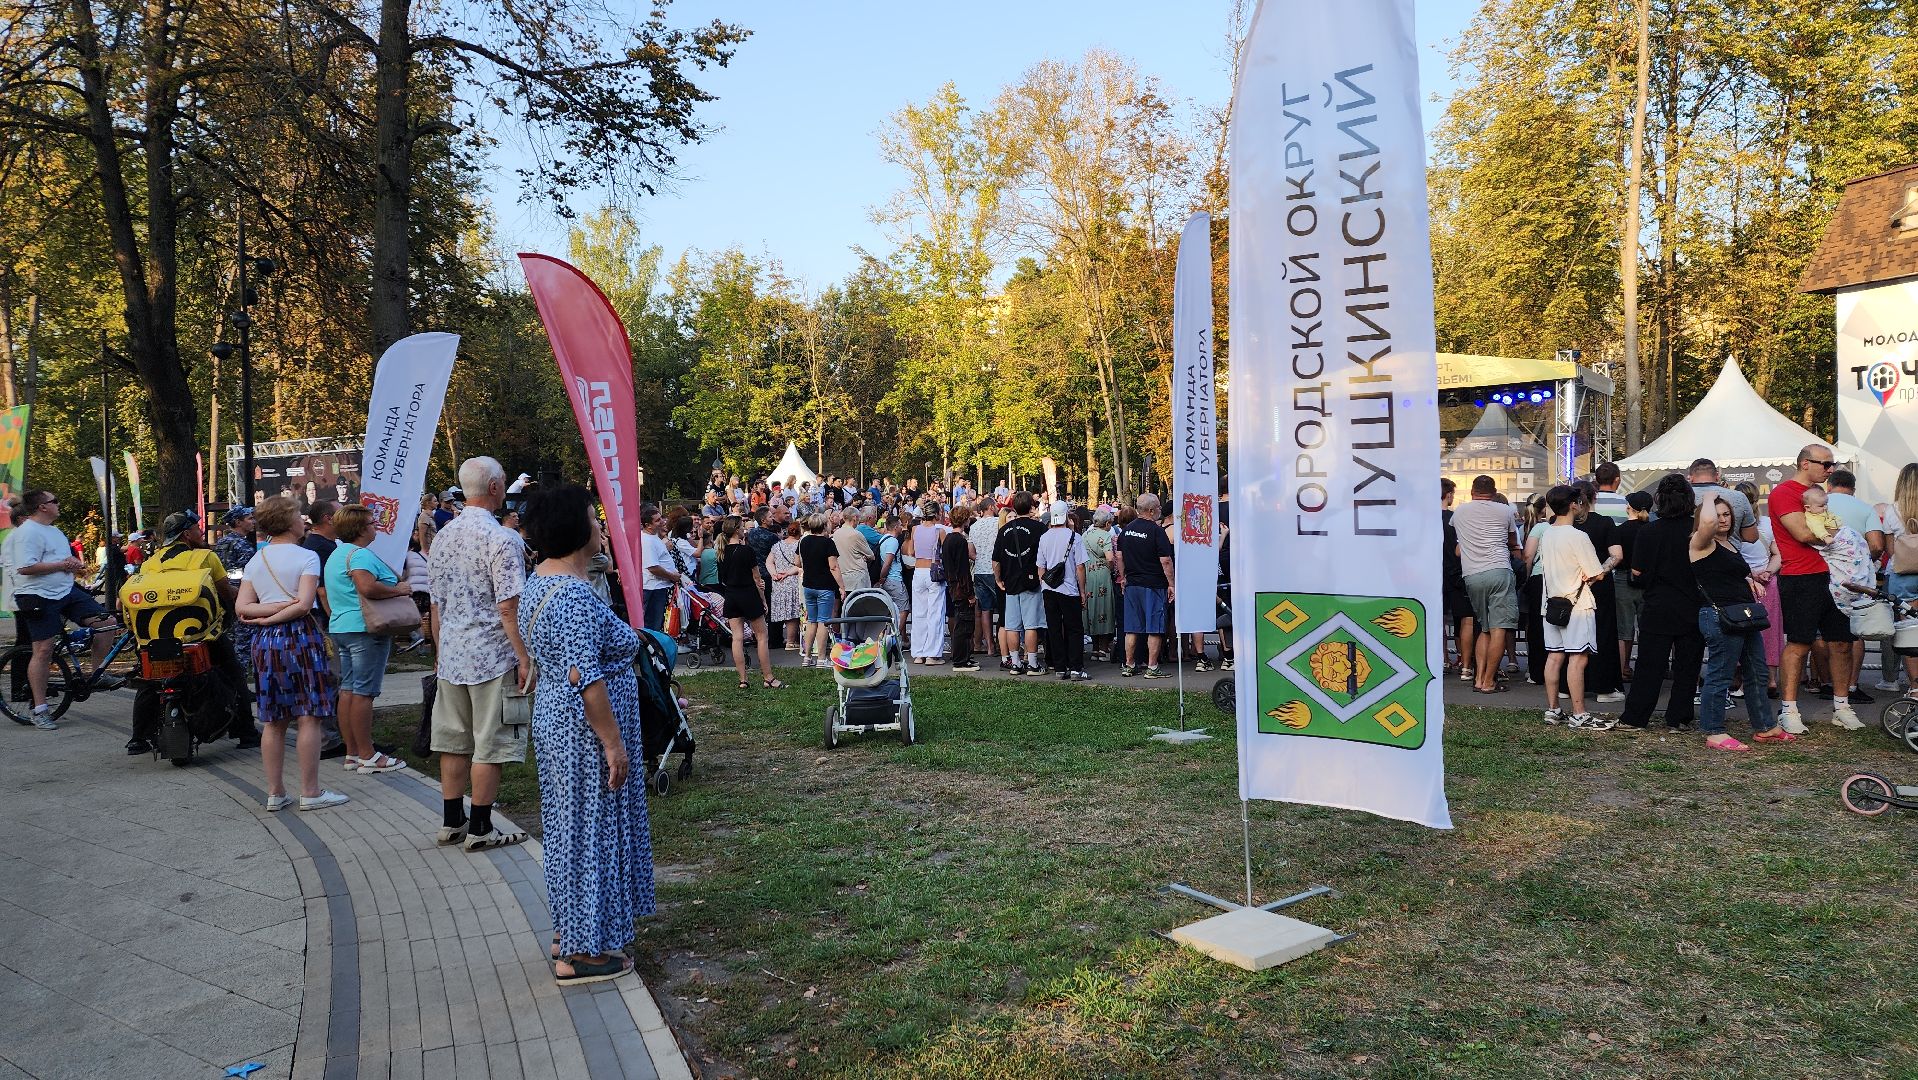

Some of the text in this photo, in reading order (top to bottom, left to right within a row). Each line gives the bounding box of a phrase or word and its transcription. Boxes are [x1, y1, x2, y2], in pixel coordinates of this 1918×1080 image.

[1281, 82, 1332, 537] ГОРОДСКОЙ ОКРУГ
[1322, 63, 1398, 537] ПУШКИНСКИЙ
[1863, 331, 1918, 347] МОЛОД
[371, 406, 401, 481] КОМАНДА
[389, 382, 426, 485] ГУБЕРНАТОРА
[1185, 364, 1196, 473] КОМАНДА
[1198, 328, 1210, 476] ГУБЕРНАТОРА
[1899, 388, 1918, 403] пр
